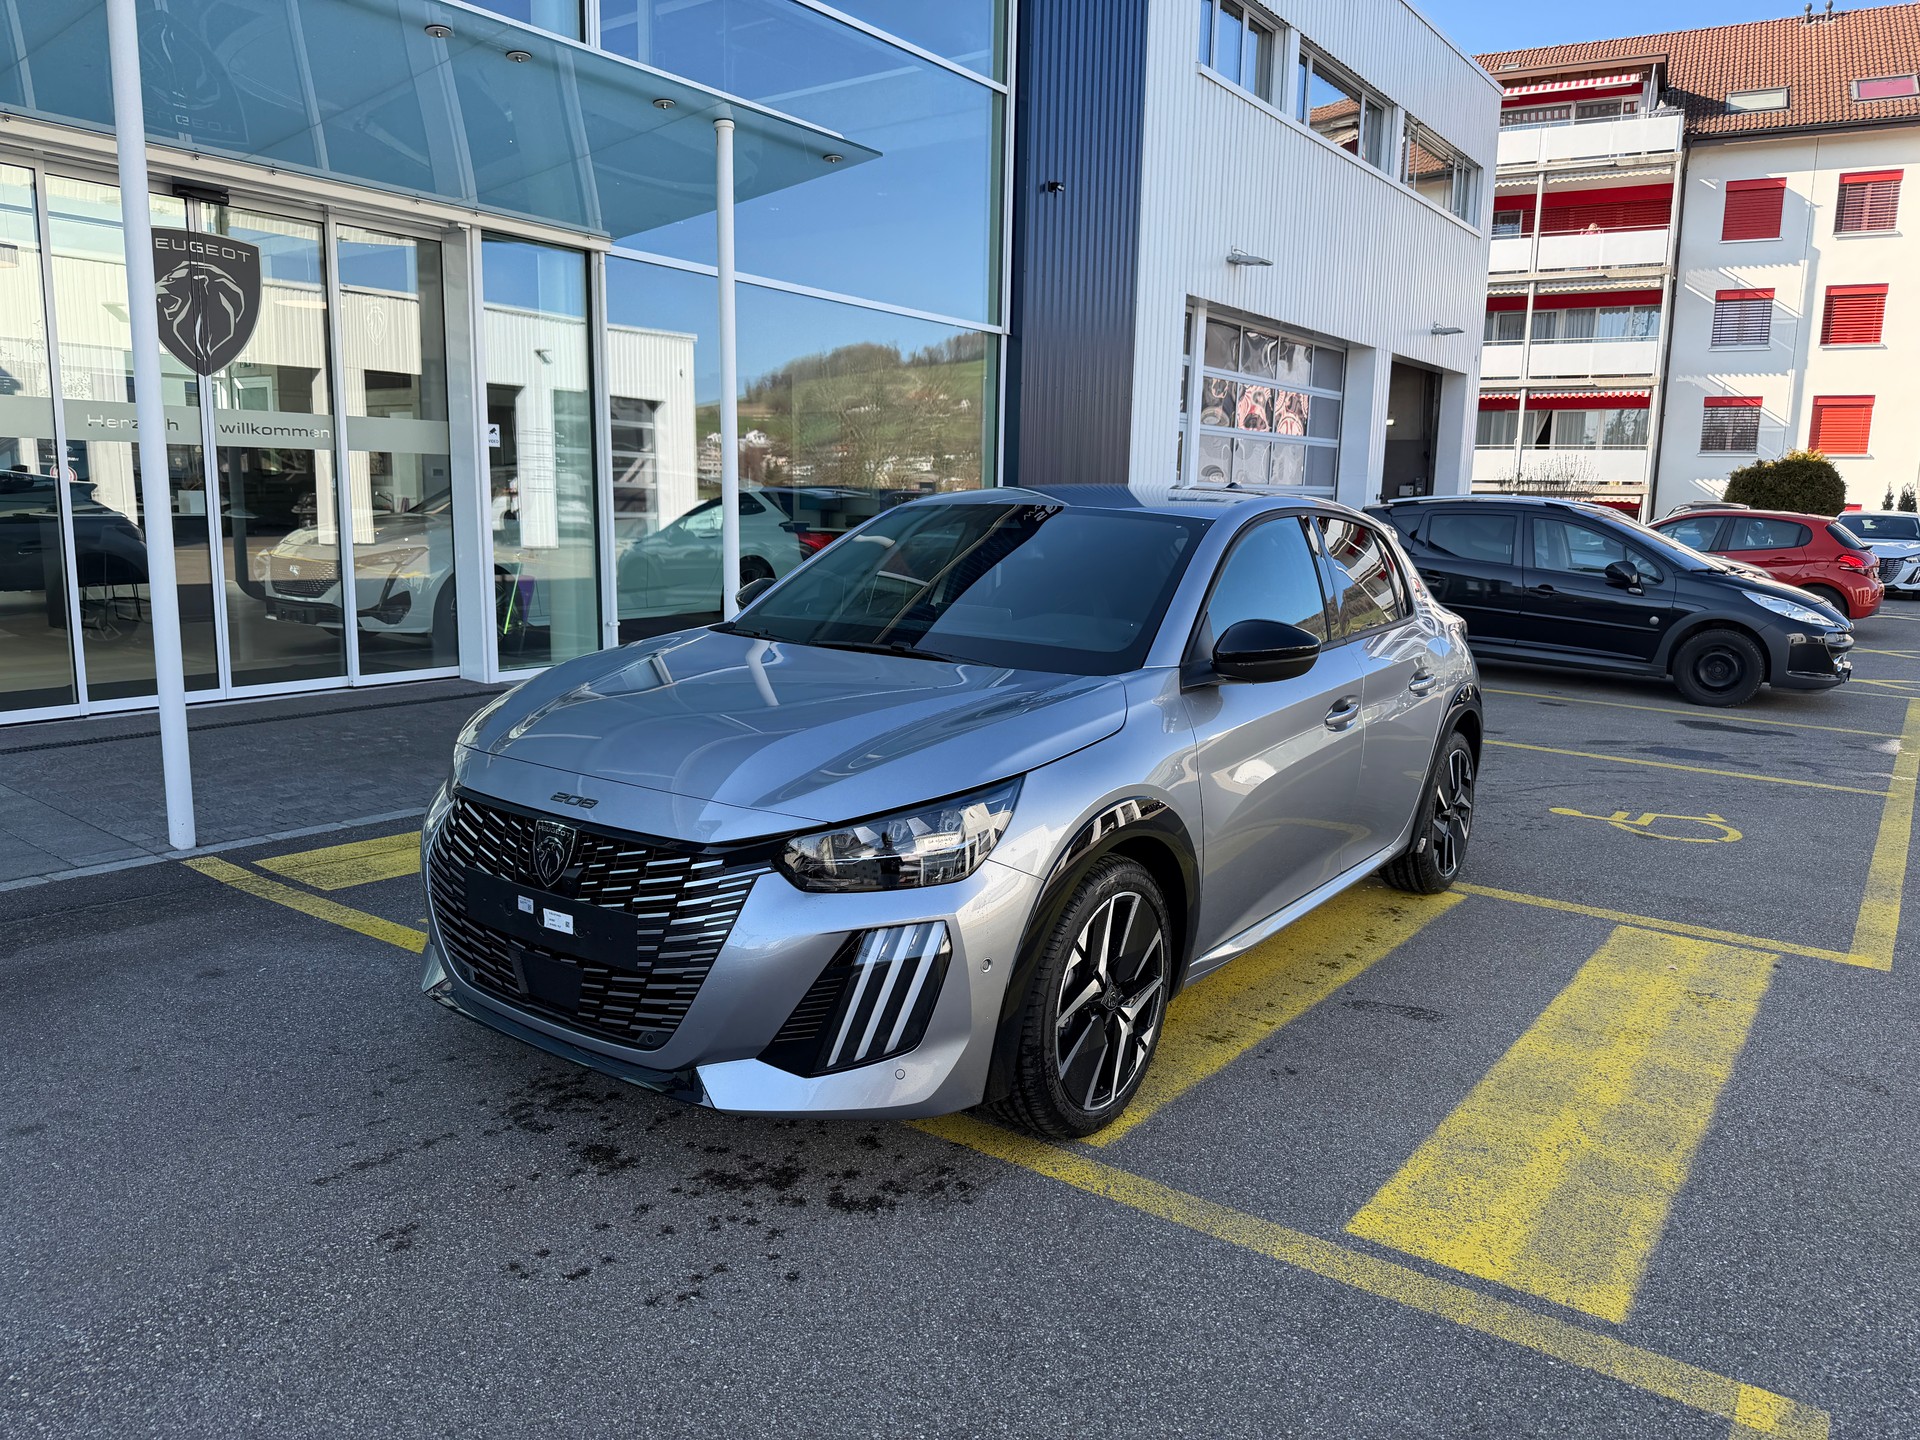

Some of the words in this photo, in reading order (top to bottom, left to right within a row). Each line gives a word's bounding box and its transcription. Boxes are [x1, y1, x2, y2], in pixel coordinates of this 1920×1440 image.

[155, 237, 251, 263] EUGEOT
[87, 414, 179, 431] Herzh
[219, 422, 331, 439] willkommen
[550, 791, 599, 809] 208
[538, 825, 573, 838] PEUGEOT
